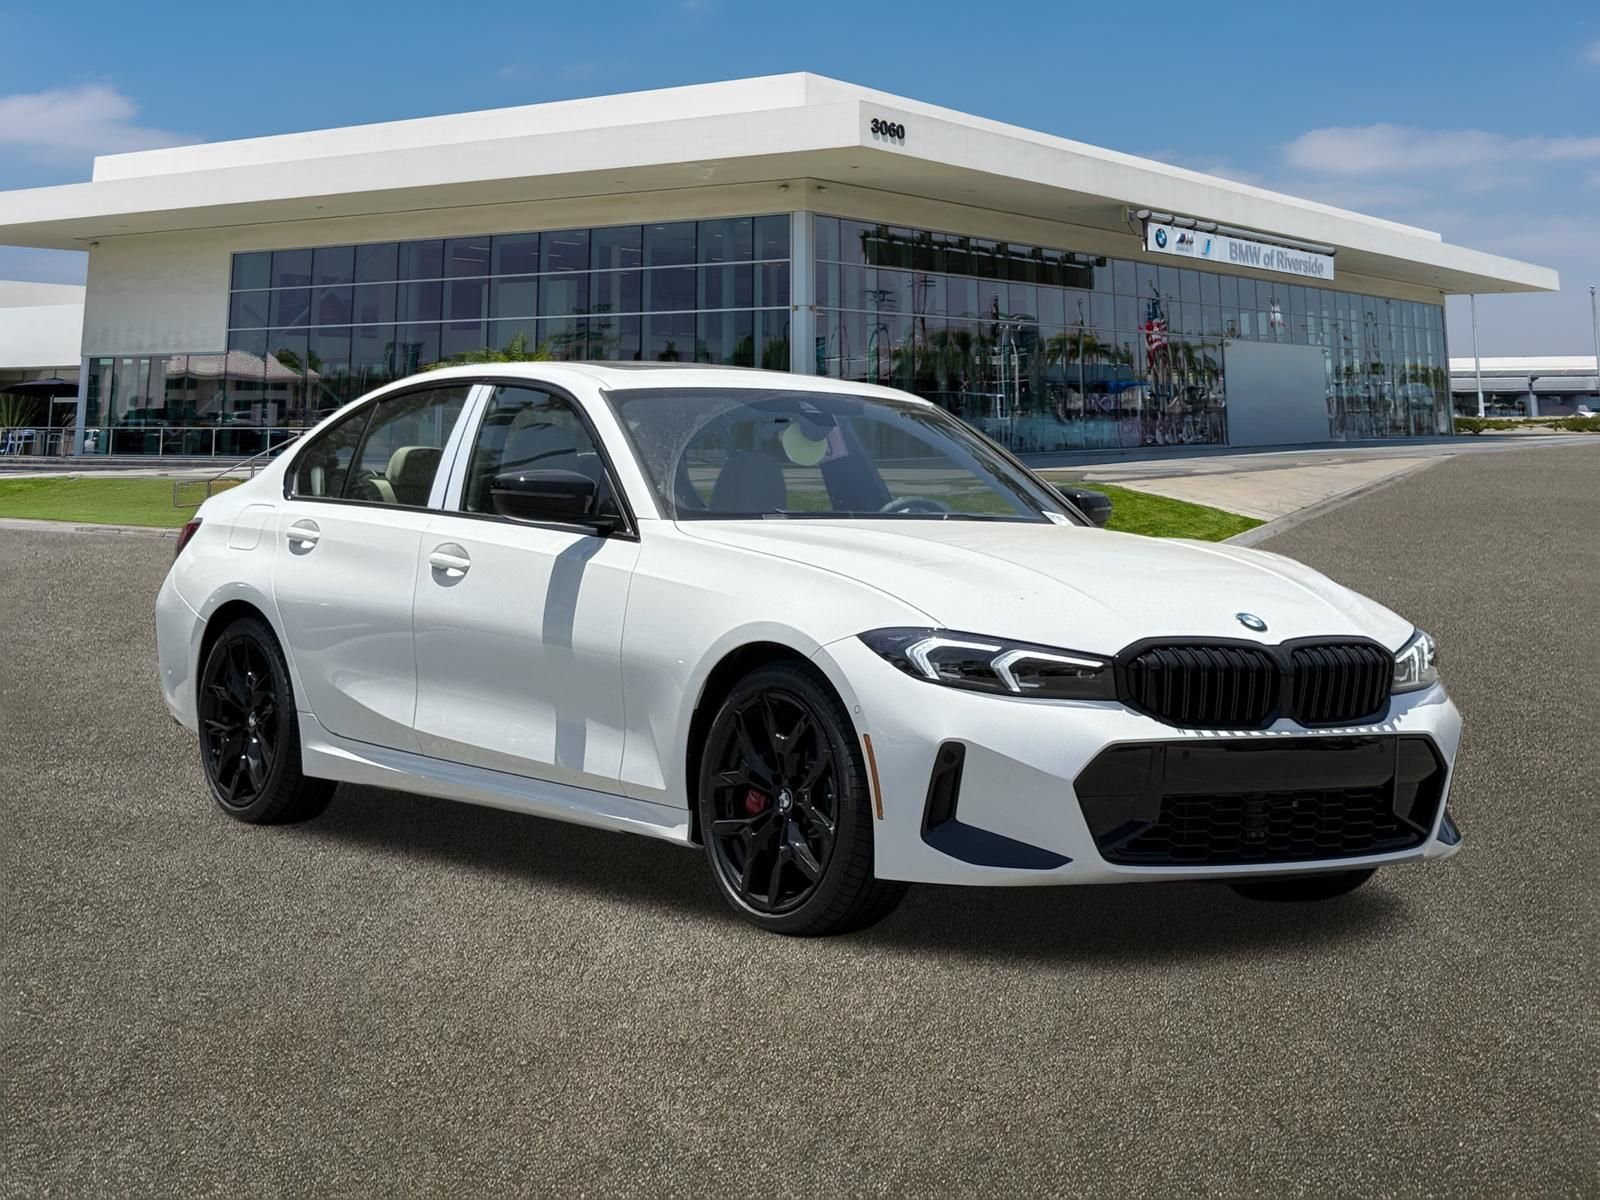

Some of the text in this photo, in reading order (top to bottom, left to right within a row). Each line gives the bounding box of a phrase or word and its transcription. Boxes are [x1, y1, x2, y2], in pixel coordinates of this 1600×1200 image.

[871, 118, 905, 139] 3060
[1229, 241, 1261, 265] BMW
[1263, 249, 1275, 268] of
[1276, 250, 1324, 275] Riverside
